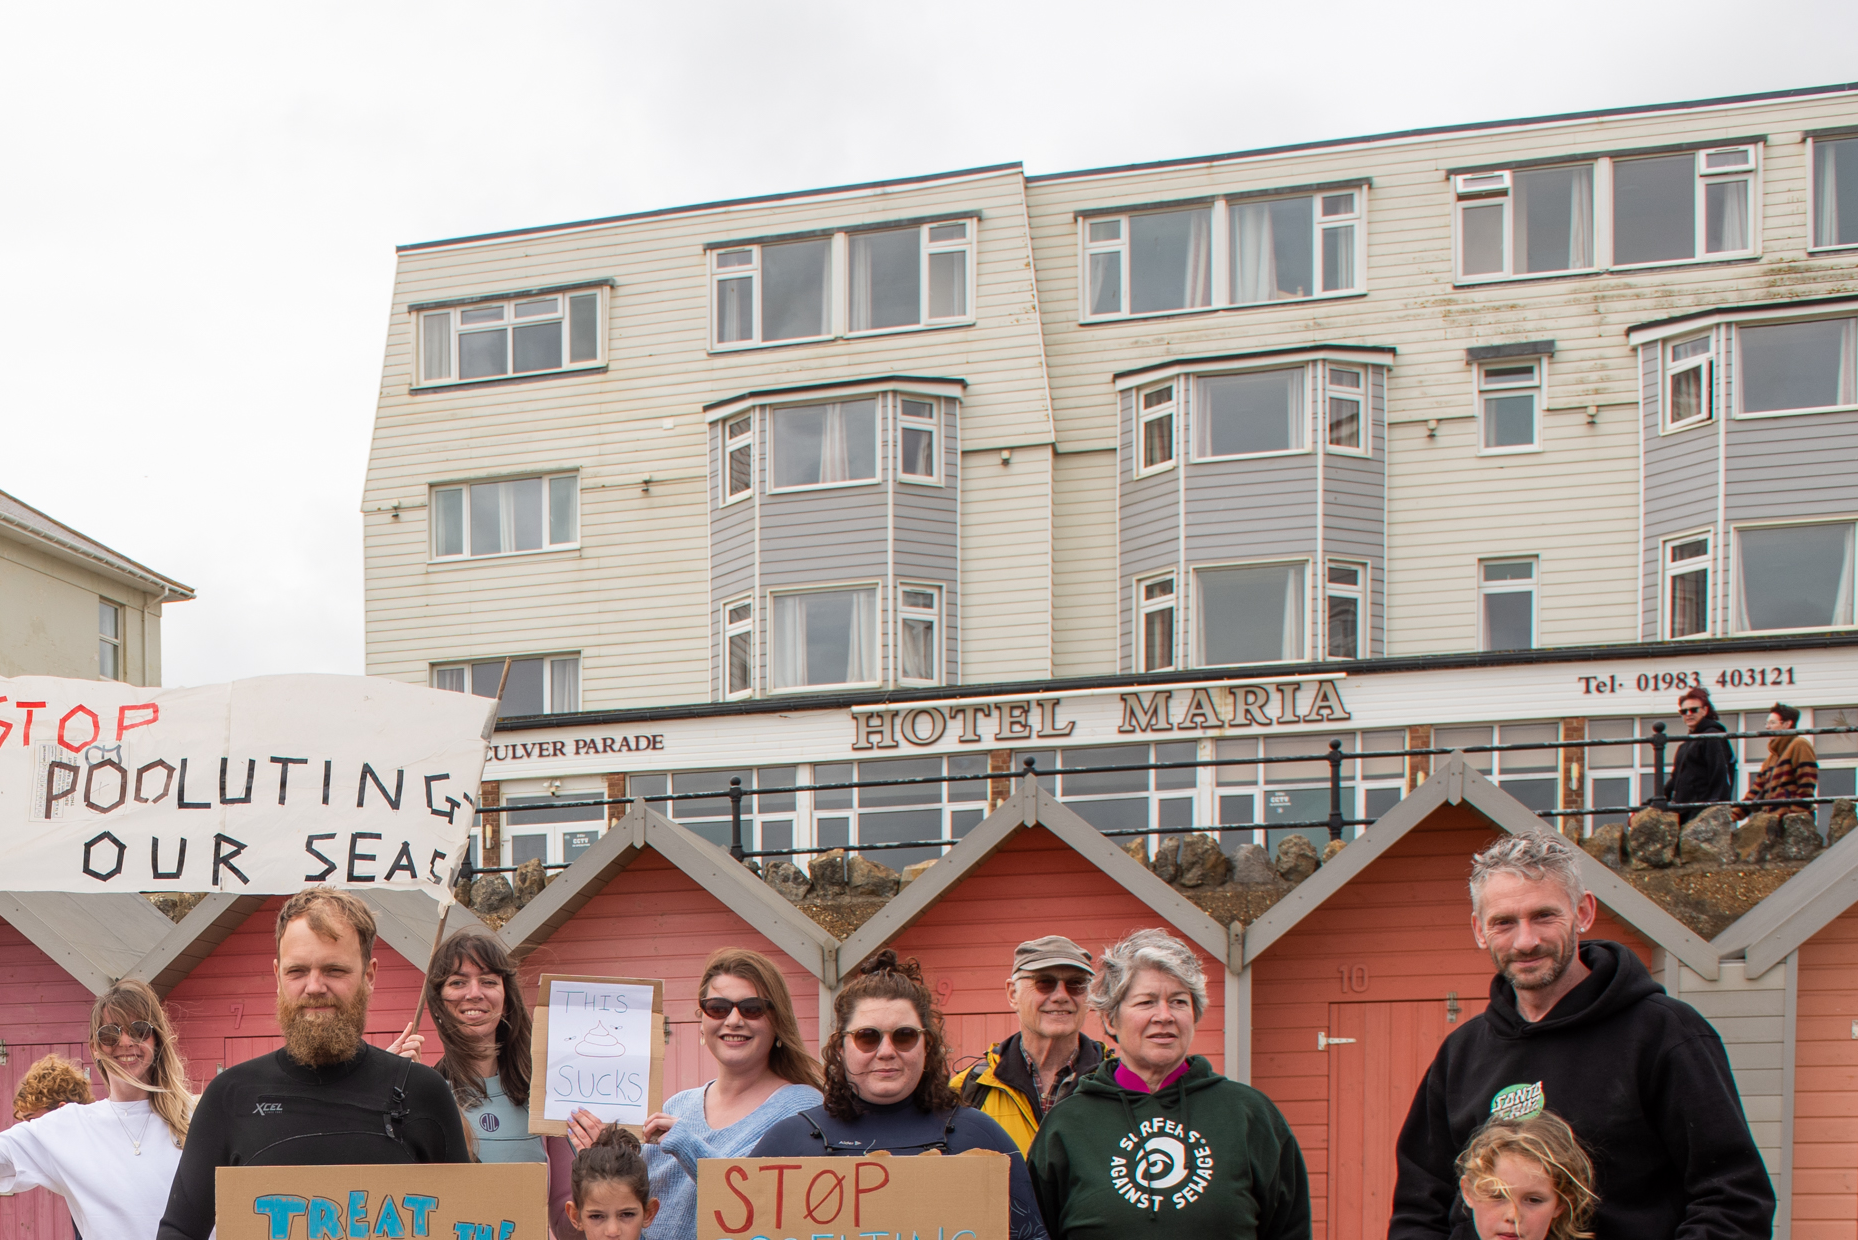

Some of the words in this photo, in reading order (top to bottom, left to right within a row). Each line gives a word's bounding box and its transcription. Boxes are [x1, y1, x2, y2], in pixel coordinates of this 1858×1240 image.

[1636, 671, 1701, 692] 01983
[1715, 666, 1795, 688] 403121
[851, 699, 1076, 750] HOTEL
[1118, 681, 1351, 734] MARIA
[574, 734, 664, 755] PARADE
[45, 755, 473, 825] POOLUTING
[83, 830, 250, 886] OUR
[305, 832, 447, 886] SEAS
[1338, 964, 1369, 993] 10
[230, 1003, 244, 1029] 7
[556, 990, 628, 1014] THIS
[553, 1064, 643, 1103] SUCKS
[1490, 1081, 1543, 1113] SANTA
[252, 1102, 283, 1115] XCEL
[1110, 1156, 1164, 1212] AGAINST
[1172, 1146, 1214, 1210] SEWAGE
